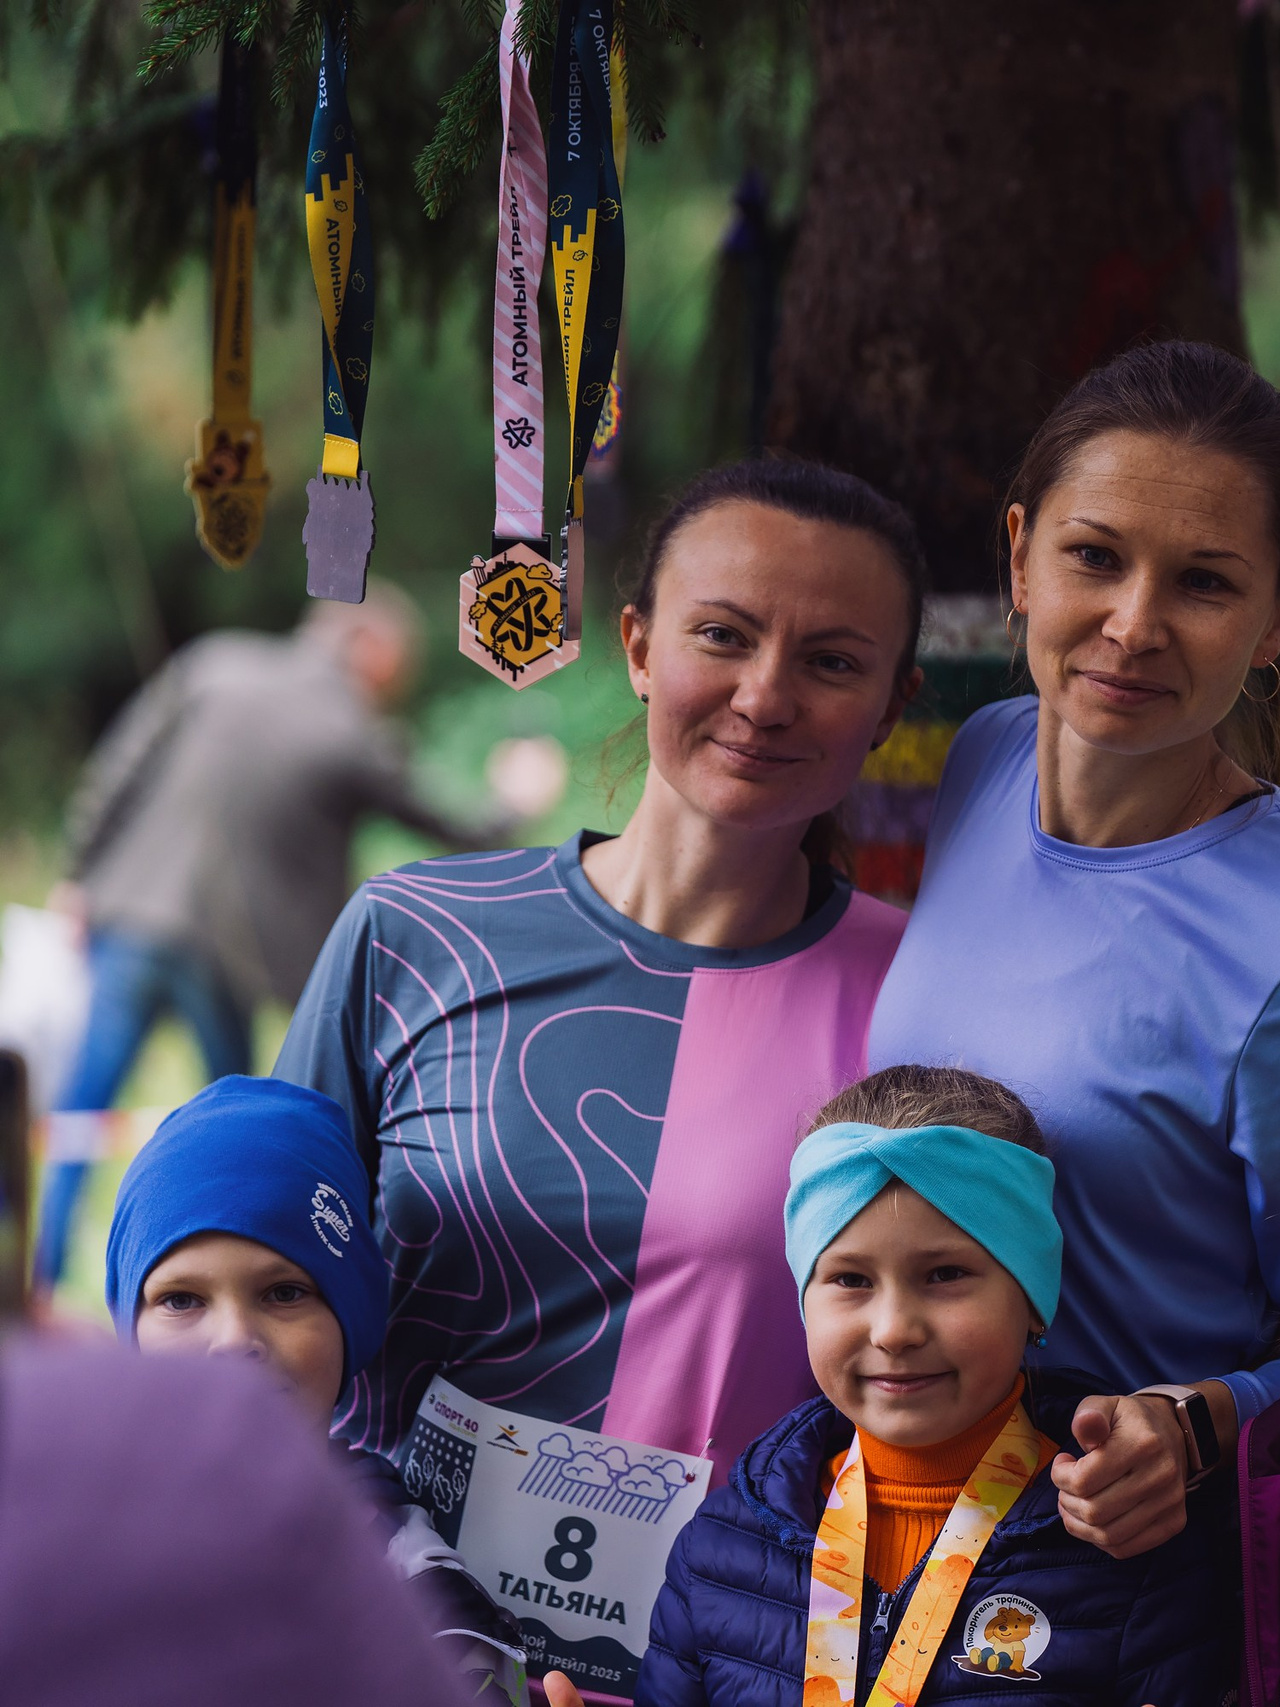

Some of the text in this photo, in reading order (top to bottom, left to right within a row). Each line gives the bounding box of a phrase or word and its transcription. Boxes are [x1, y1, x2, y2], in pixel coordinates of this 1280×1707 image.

[567, 61, 582, 147] ОКТЯБРЯ
[507, 185, 528, 387] АТОМНЫЙ ТРЕЙЛ
[562, 268, 575, 331] ТРЕЙЛ
[493, 589, 537, 630] АТОМНЫЙ ТРЕЙЛ
[434, 1401, 464, 1432] СПОРТ
[465, 1418, 479, 1433] 40
[544, 1516, 597, 1582] 8
[498, 1571, 626, 1626] ТАТЬЯНА
[966, 1595, 1040, 1648] Покоритель тропинок
[546, 1652, 588, 1674] ТРЕЙЛ
[590, 1663, 623, 1683] 2025
